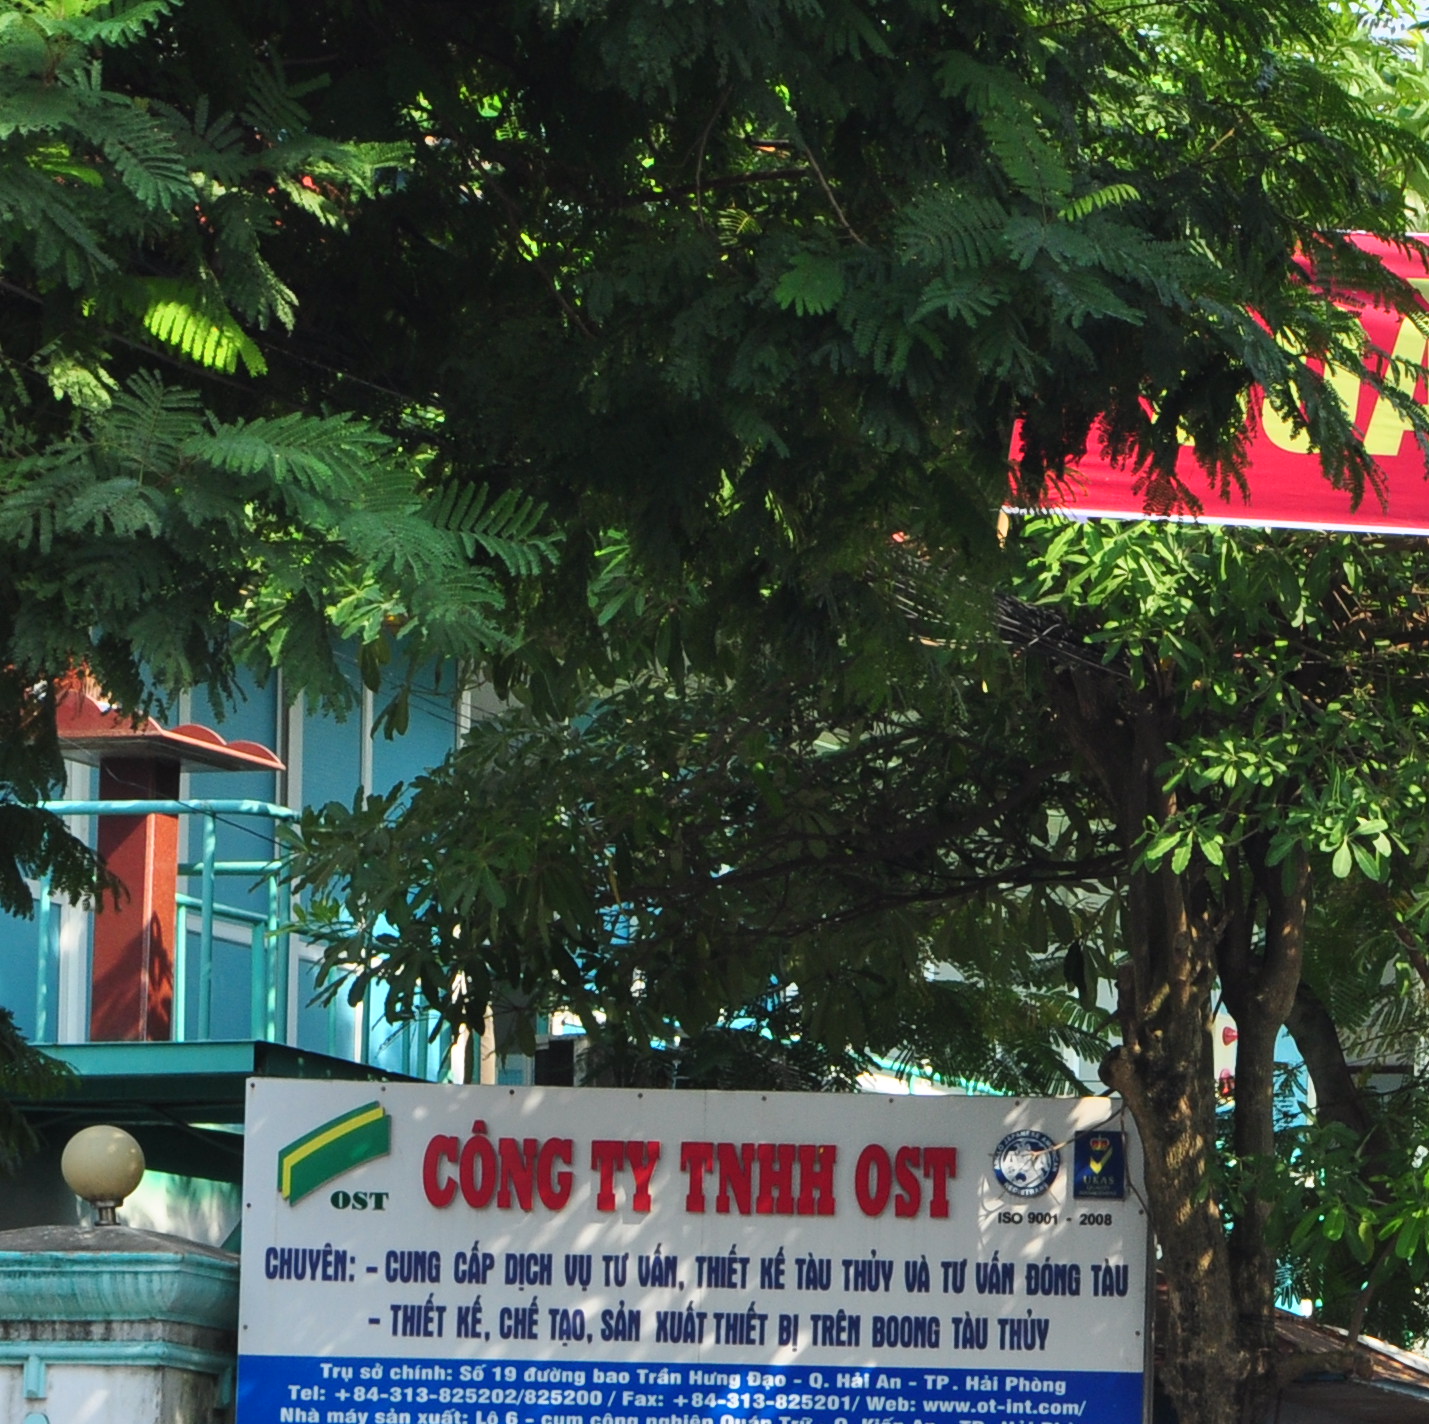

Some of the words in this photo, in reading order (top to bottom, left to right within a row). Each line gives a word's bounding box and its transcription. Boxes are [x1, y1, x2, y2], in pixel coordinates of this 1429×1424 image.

[423, 1120, 574, 1212] CÔNG
[591, 1139, 661, 1213] TY
[680, 1142, 836, 1215] TNHH
[855, 1144, 957, 1218] OST
[330, 1191, 389, 1210] OST
[998, 1212, 1022, 1225] ISO
[1028, 1212, 1058, 1225] 9001
[1079, 1213, 1112, 1226] 2008
[265, 1242, 356, 1282] CHUYÊN:
[385, 1250, 441, 1283] CUNG
[454, 1240, 495, 1284] CẤP
[505, 1252, 552, 1291] DỊCH
[565, 1254, 592, 1291] VỤ
[602, 1252, 629, 1287] TƯ
[638, 1242, 684, 1291] VẤN,
[695, 1243, 750, 1290] THIẾT
[761, 1246, 785, 1290] KẾ
[795, 1252, 832, 1291] TÀU
[842, 1249, 894, 1292] THỦY
[904, 1254, 930, 1293] VÀ
[941, 1258, 967, 1294] TƯ
[975, 1250, 1015, 1295] VẤN
[1026, 1256, 1080, 1297] ĐÓNG
[1091, 1258, 1129, 1297] TÀU
[390, 1292, 446, 1338] THIẾT
[457, 1294, 490, 1342] KẾ,
[500, 1295, 539, 1340] CHẾ
[548, 1308, 593, 1347] TẠO,
[600, 1300, 641, 1341] SẢN
[656, 1300, 707, 1344] XUẤT
[713, 1301, 768, 1346] THIẾT
[779, 1314, 799, 1352] BỊ
[811, 1308, 860, 1347] TRÊN
[872, 1315, 940, 1349] BOONG
[951, 1311, 988, 1350] TÀU
[997, 1309, 1050, 1351] THỦY
[320, 1363, 353, 1382] Trụ
[359, 1362, 383, 1380] sở
[390, 1364, 453, 1381] chính:
[459, 1364, 487, 1381] Số
[492, 1366, 516, 1382] 19
[524, 1366, 586, 1387] đường
[593, 1368, 630, 1384] bao
[636, 1368, 681, 1385] Trần
[689, 1369, 741, 1389] Hưng
[747, 1371, 787, 1391] Đạo
[809, 1372, 829, 1389] Q.
[836, 1372, 870, 1389] Hải
[876, 1374, 901, 1389] An
[965, 1376, 998, 1391] Hải
[1005, 1377, 1066, 1395] Phòng
[280, 1407, 320, 1423] Nhà
[374, 1408, 411, 1424] sản
[288, 1385, 326, 1401] Tel:
[335, 1386, 602, 1405] +84-313-825202/825200
[622, 1391, 663, 1407] Fax:
[866, 1396, 916, 1412] Web:
[923, 1400, 1086, 1416] www.ot-int.com/
